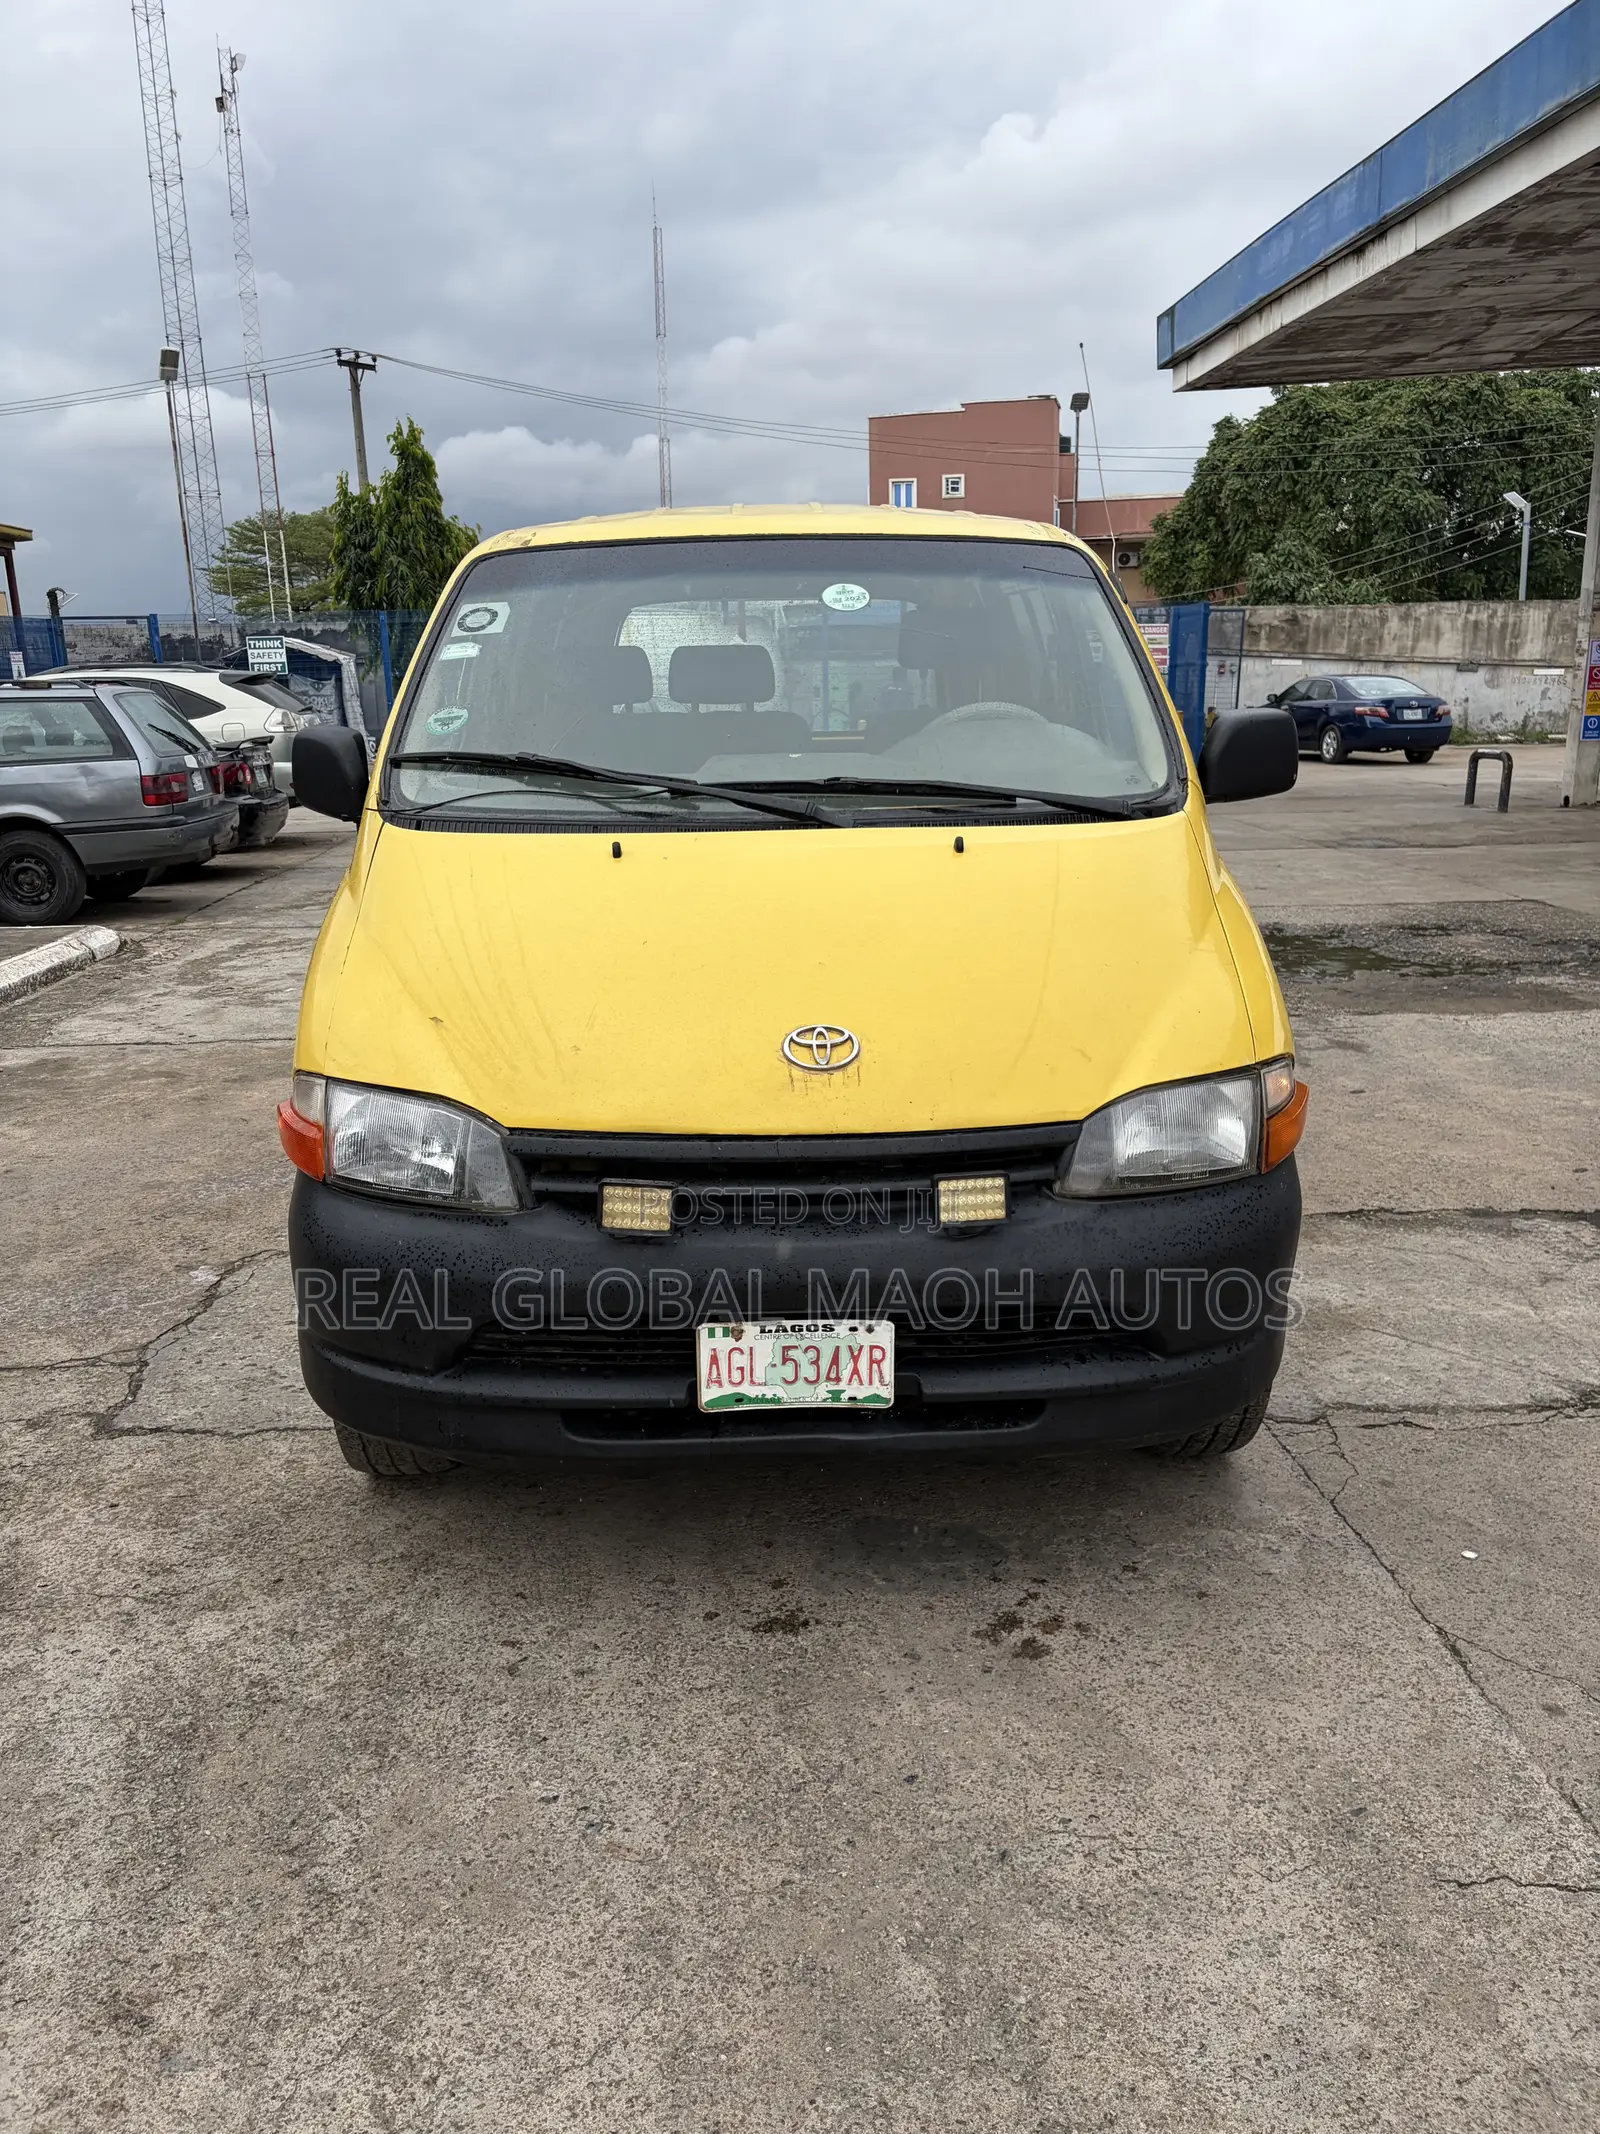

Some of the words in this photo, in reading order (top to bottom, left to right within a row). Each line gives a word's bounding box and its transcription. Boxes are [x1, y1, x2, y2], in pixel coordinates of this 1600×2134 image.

[248, 640, 282, 649] THINK
[250, 651, 284, 660] SAFETY
[253, 663, 283, 672] FIRST
[759, 1323, 836, 1334] LAGOS
[753, 1333, 783, 1341] CENTRE
[783, 1332, 795, 1340] OF
[795, 1332, 841, 1341] EXCELLENCE
